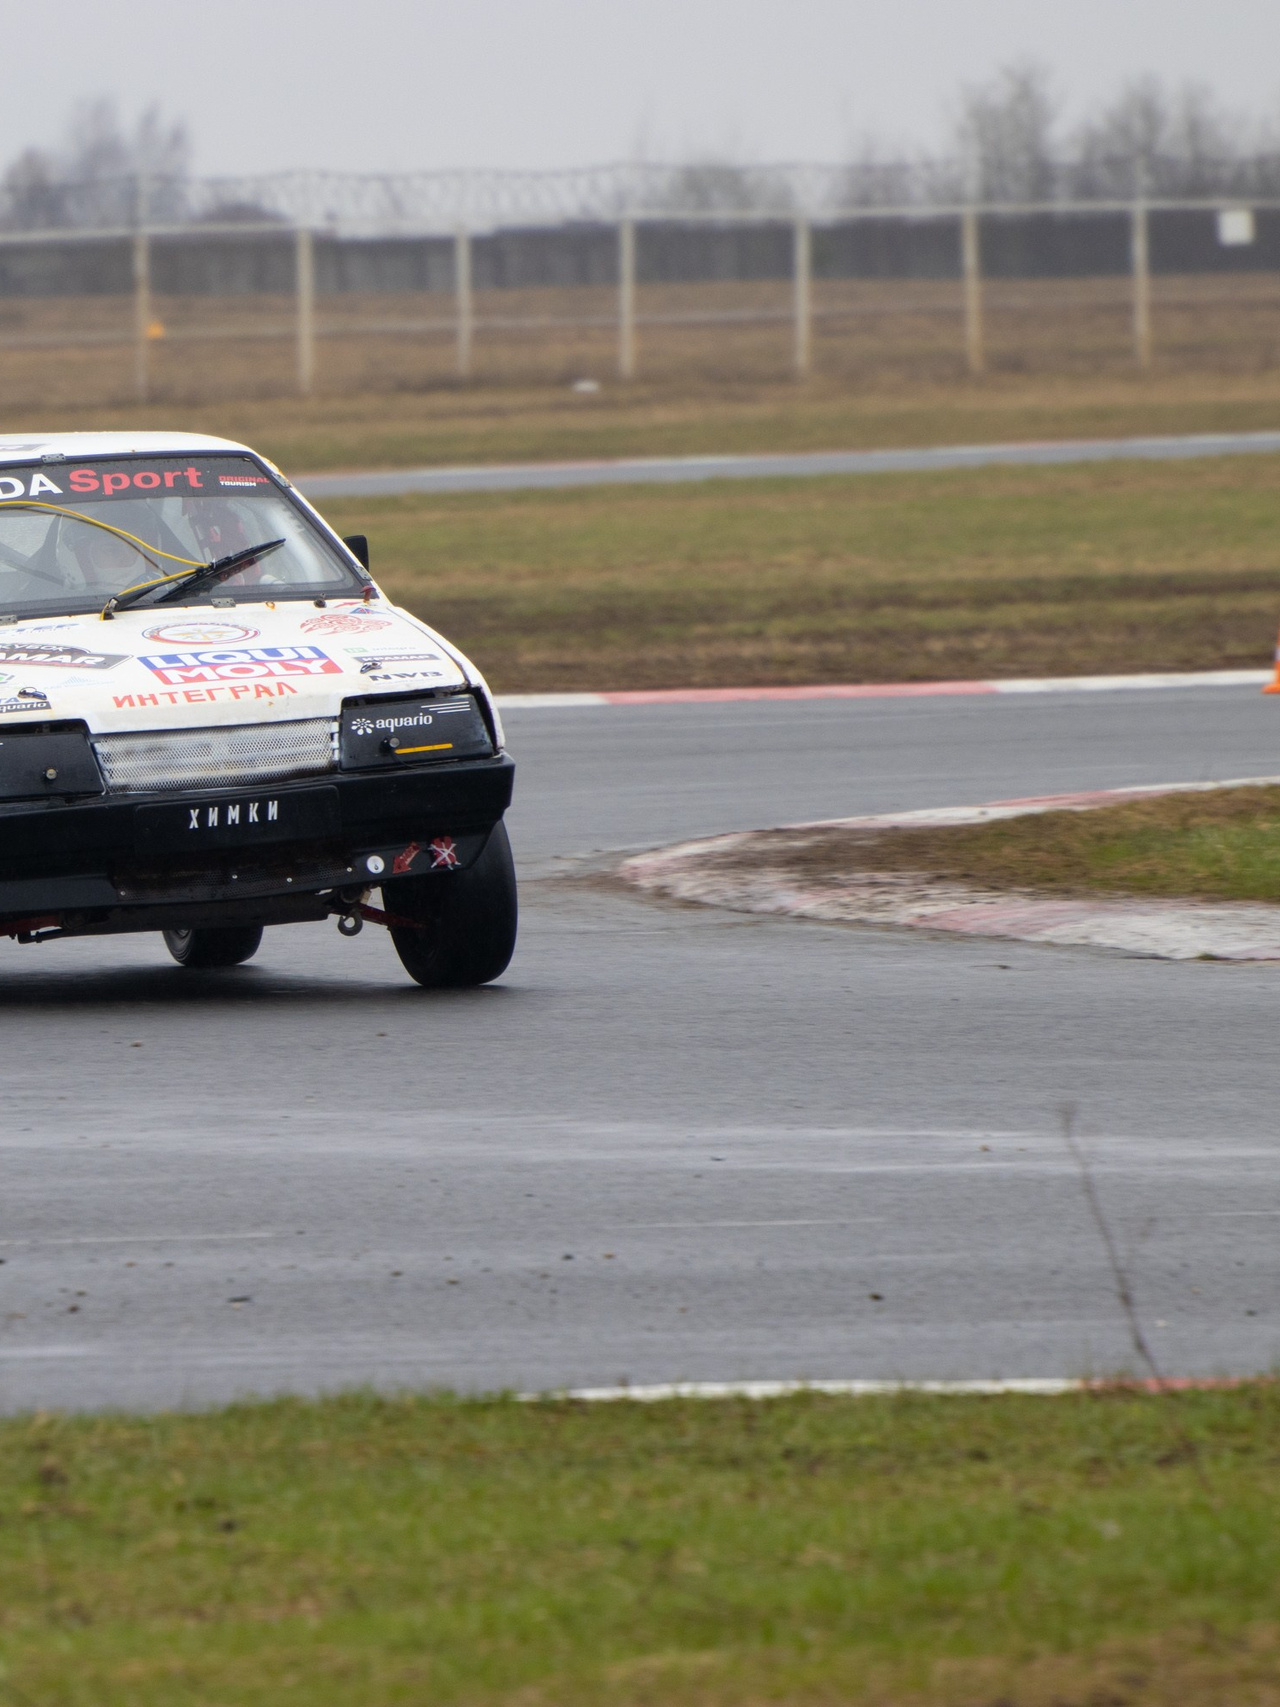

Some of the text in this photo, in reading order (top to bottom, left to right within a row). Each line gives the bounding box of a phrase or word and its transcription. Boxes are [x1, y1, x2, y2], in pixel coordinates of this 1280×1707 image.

[69, 467, 204, 496] Sport
[219, 475, 269, 484] ORIGINAL
[146, 647, 319, 669] LIQUI
[163, 659, 328, 684] MOLY
[369, 671, 443, 681] NWB
[112, 681, 299, 709] ИНТЕГРАЛ
[375, 712, 433, 733] aquario
[189, 801, 278, 829] ХИМКИ
